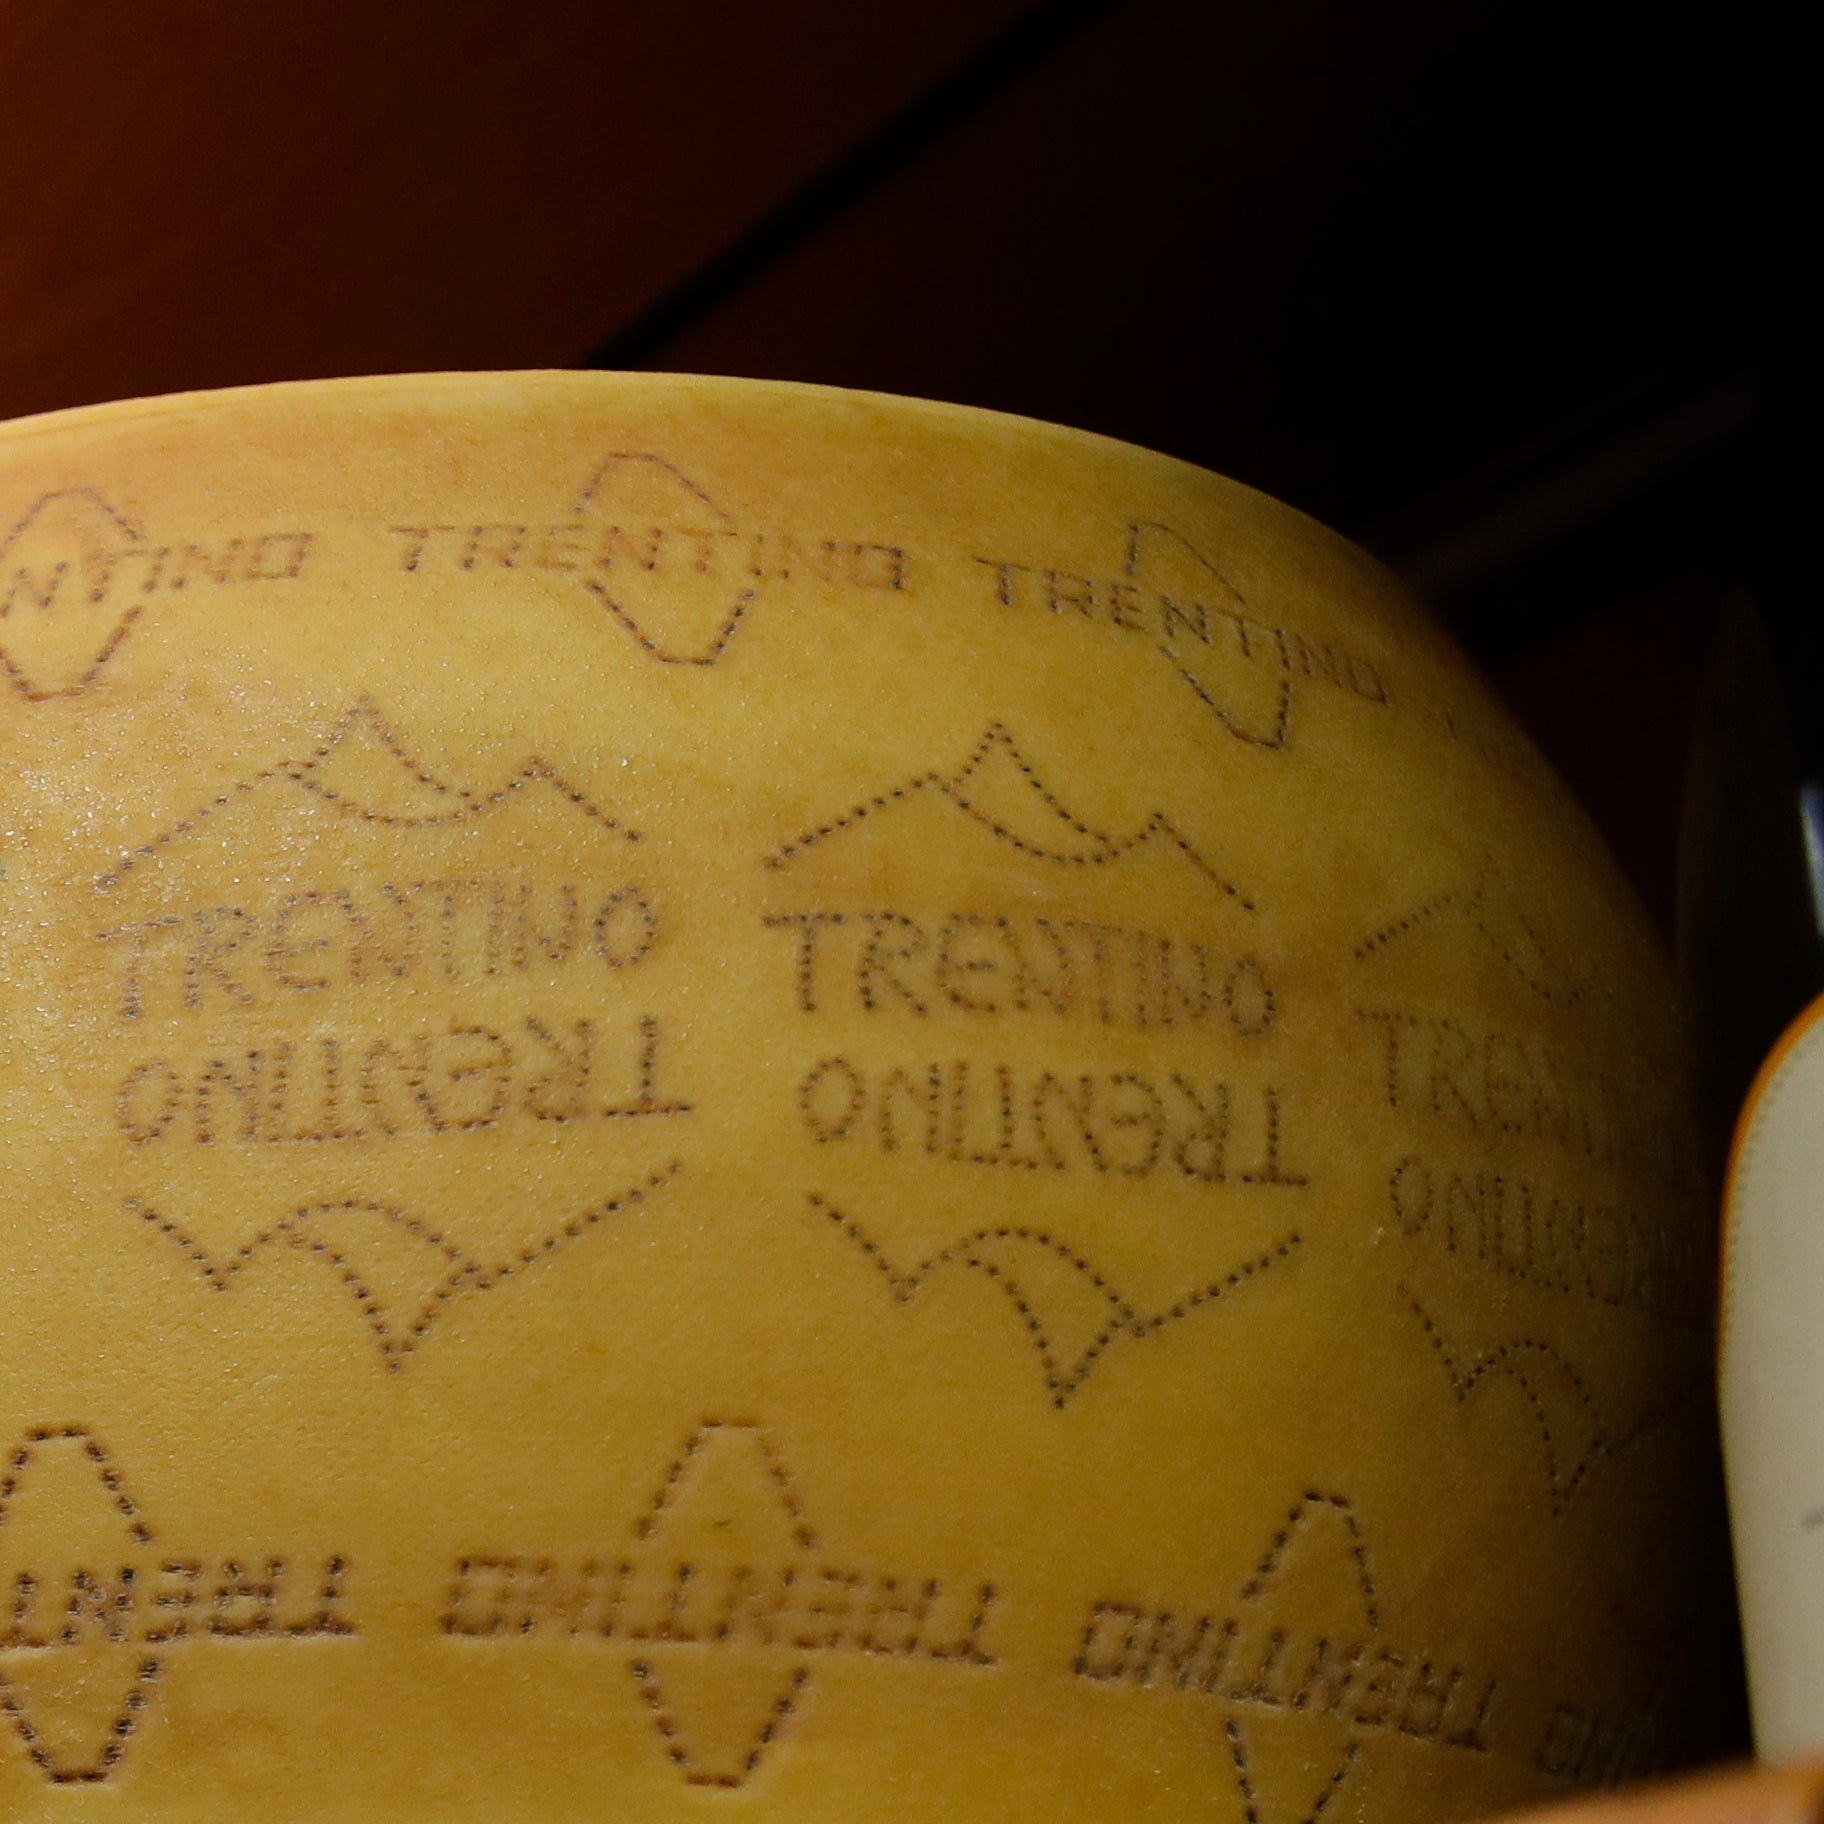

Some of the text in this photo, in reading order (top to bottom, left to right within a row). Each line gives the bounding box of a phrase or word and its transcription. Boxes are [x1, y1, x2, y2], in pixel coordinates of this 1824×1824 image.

[388, 524, 908, 592] TRENTINO
[970, 556, 1389, 708] TRENTINO
[94, 878, 658, 1020] TRENTINO
[761, 911, 1276, 1038] TRENTINO
[114, 1016, 693, 1145] TRENTINO
[799, 1056, 1309, 1186] TRENTINO
